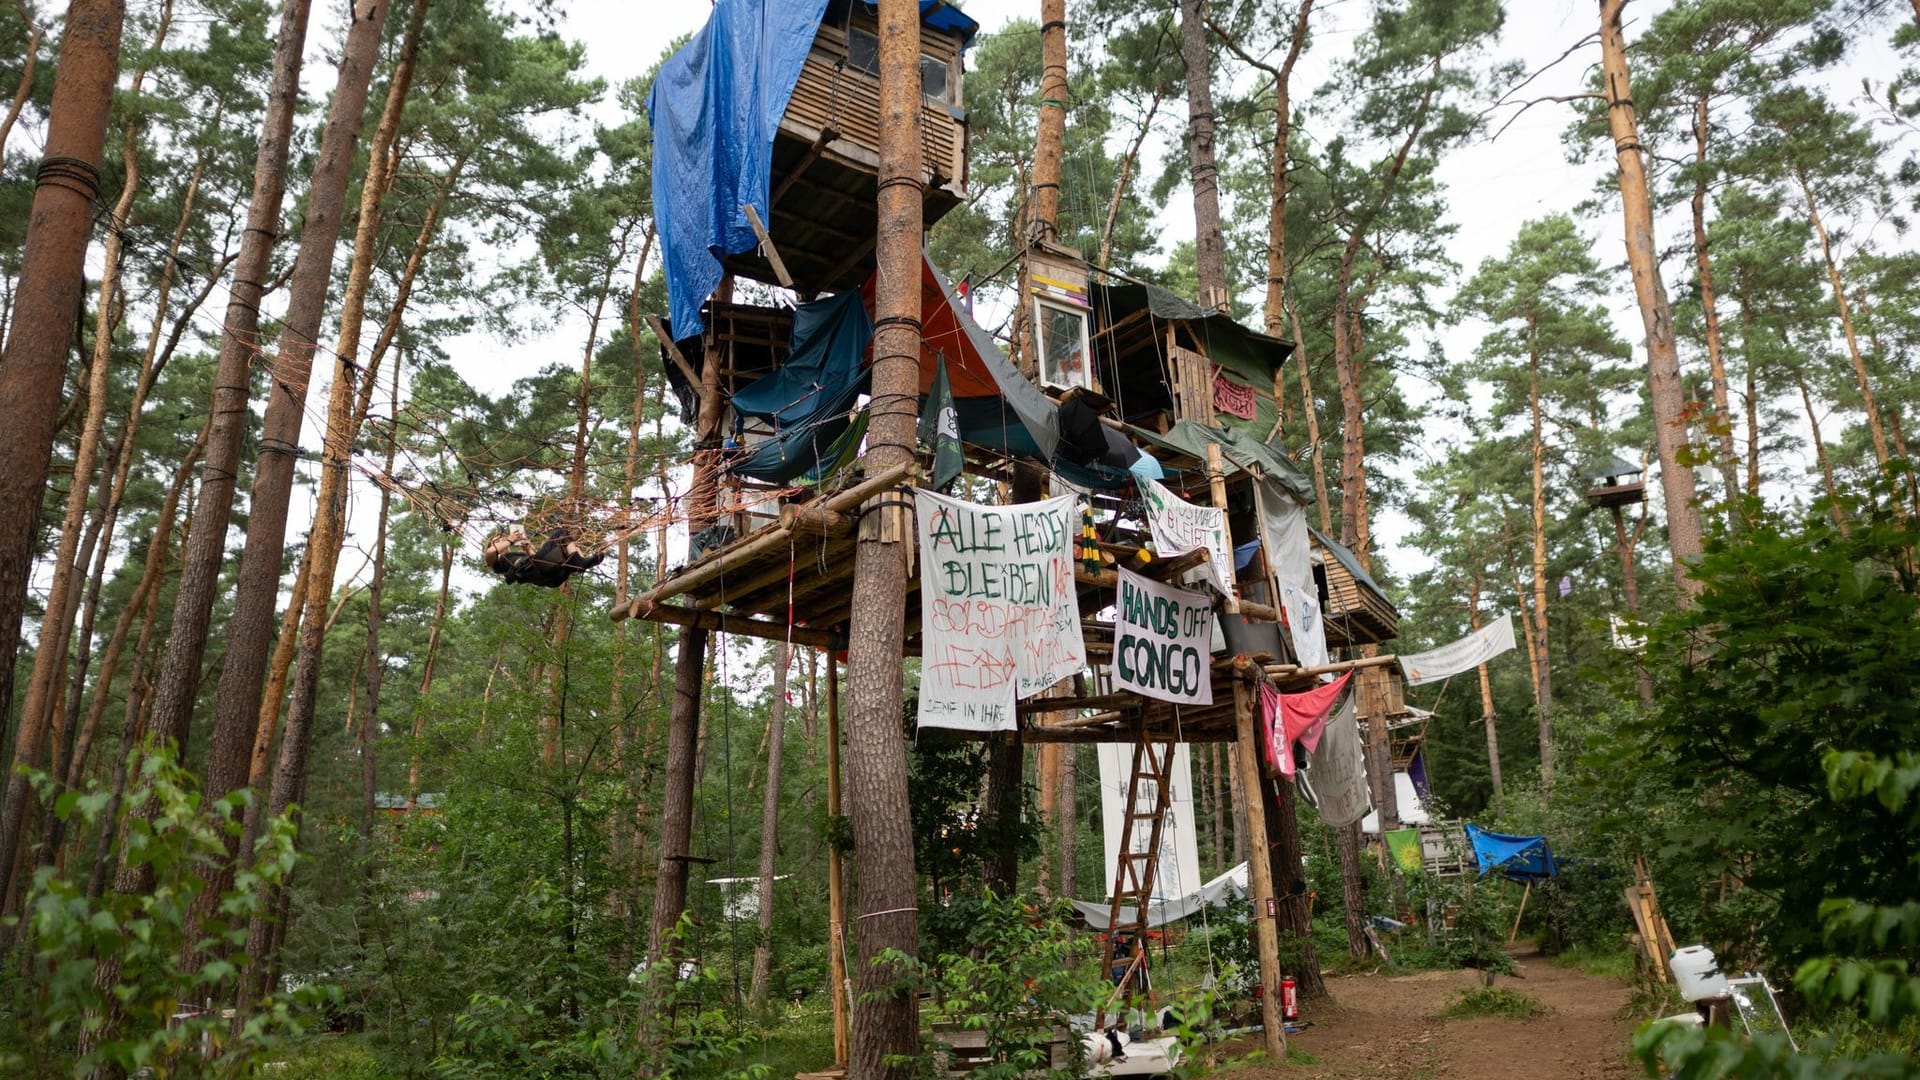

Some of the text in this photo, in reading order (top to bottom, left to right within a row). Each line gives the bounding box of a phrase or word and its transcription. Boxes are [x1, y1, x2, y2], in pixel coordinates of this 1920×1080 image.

[930, 504, 1005, 554] ALLE
[1122, 580, 1180, 639] HANDS
[1183, 606, 1209, 637] OFF
[1118, 634, 1200, 697] CONGO
[964, 701, 976, 721] IN
[980, 704, 1006, 723] IHRE
